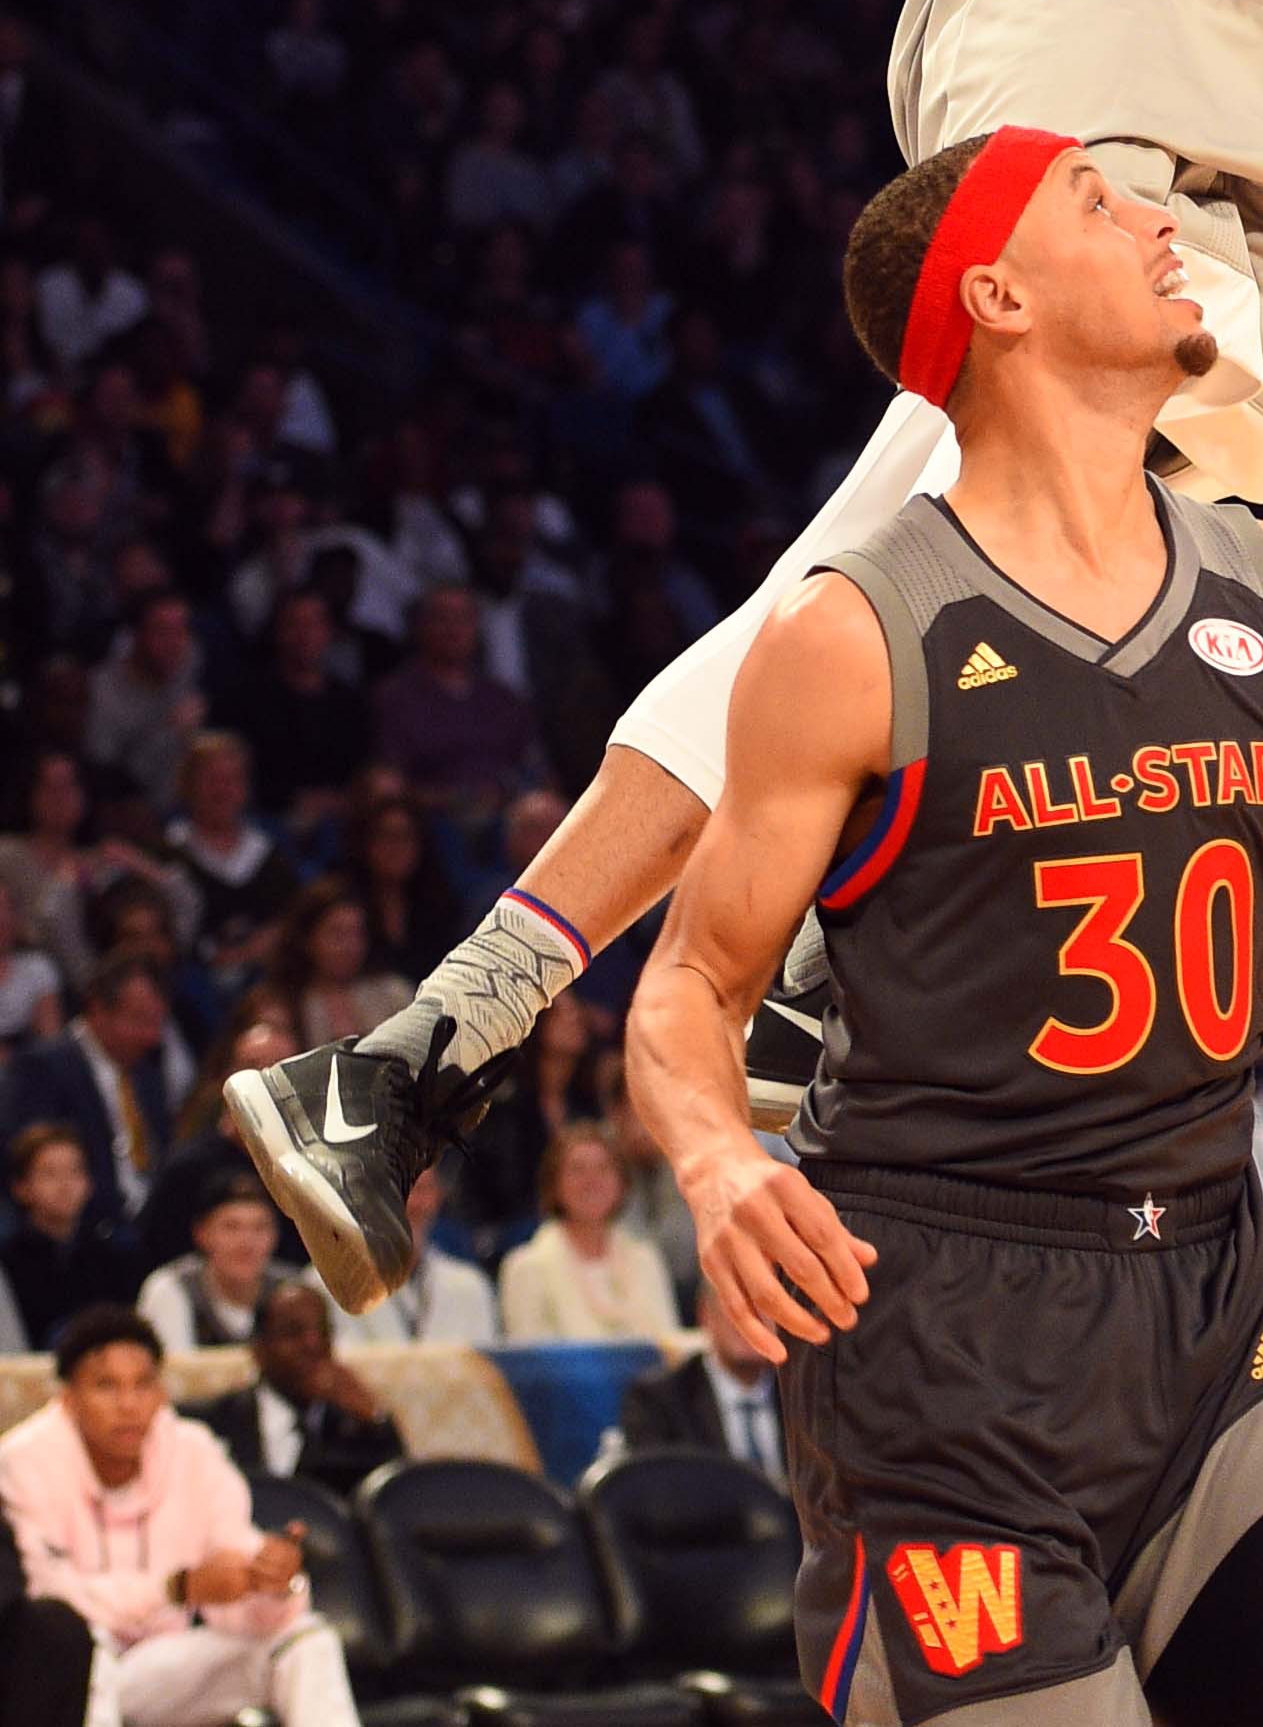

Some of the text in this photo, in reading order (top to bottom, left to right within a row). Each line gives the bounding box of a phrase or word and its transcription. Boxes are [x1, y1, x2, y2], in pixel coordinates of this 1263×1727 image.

[957, 665, 1018, 689] adidas
[1206, 631, 1253, 662] KIA
[1028, 838, 1254, 1075] 30
[887, 1541, 1022, 1678] W
